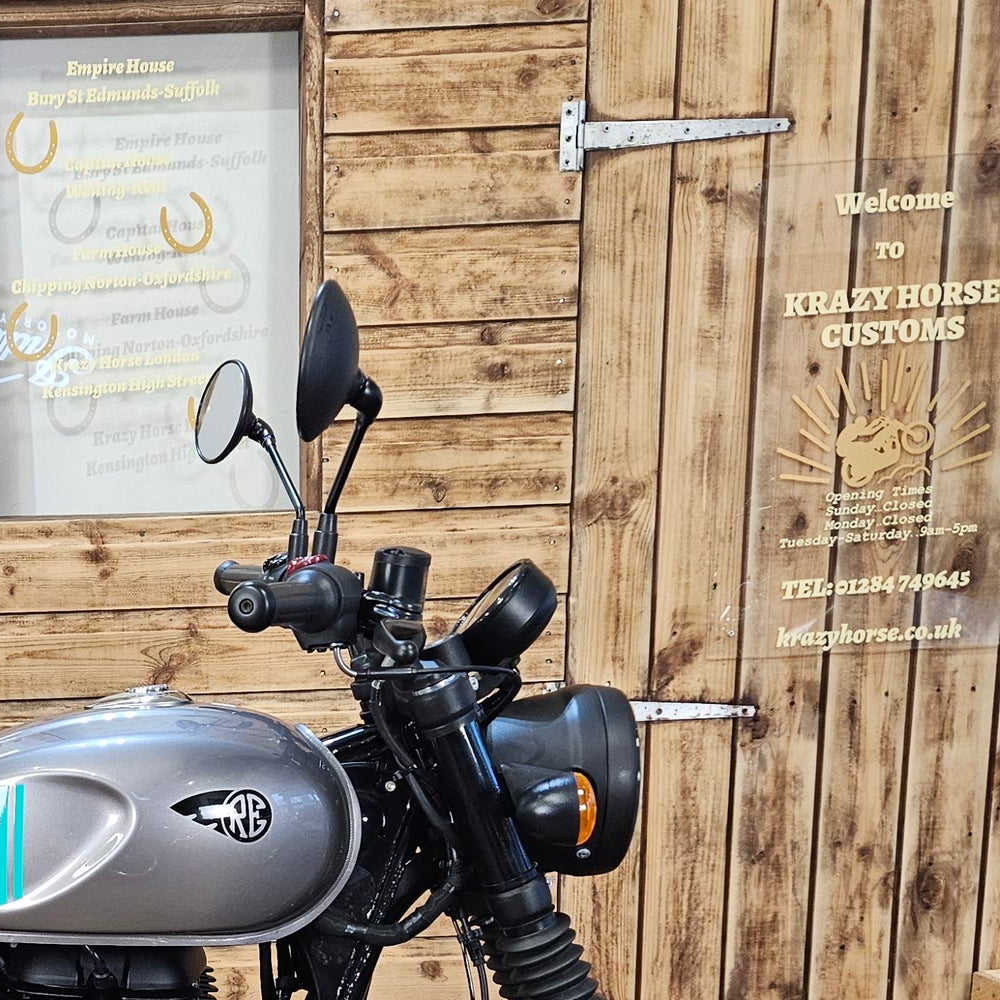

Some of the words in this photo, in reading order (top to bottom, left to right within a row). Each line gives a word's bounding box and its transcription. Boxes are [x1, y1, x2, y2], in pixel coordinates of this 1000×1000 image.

[66, 58, 124, 80] Empire
[125, 58, 175, 74] House
[26, 90, 66, 110] Bury
[66, 88, 84, 105] St
[85, 79, 220, 104] Edmunds-Suffolk
[173, 132, 223, 146] House
[835, 188, 956, 216] Welcome
[874, 241, 905, 260] TO
[11, 280, 81, 297] Chipping
[82, 266, 232, 290] Norton-Oxfordshire
[784, 285, 894, 318] KRAZY
[895, 279, 1000, 309] HORSE
[821, 315, 966, 349] CUSTOMS
[99, 355, 142, 370] Horse
[144, 351, 200, 366] London
[43, 382, 127, 400] Kensington
[130, 376, 166, 394] High
[826, 489, 884, 504] Opening
[892, 484, 934, 497] Times
[898, 569, 971, 593] 749645
[776, 617, 963, 652] krazyhorse.co.uk
